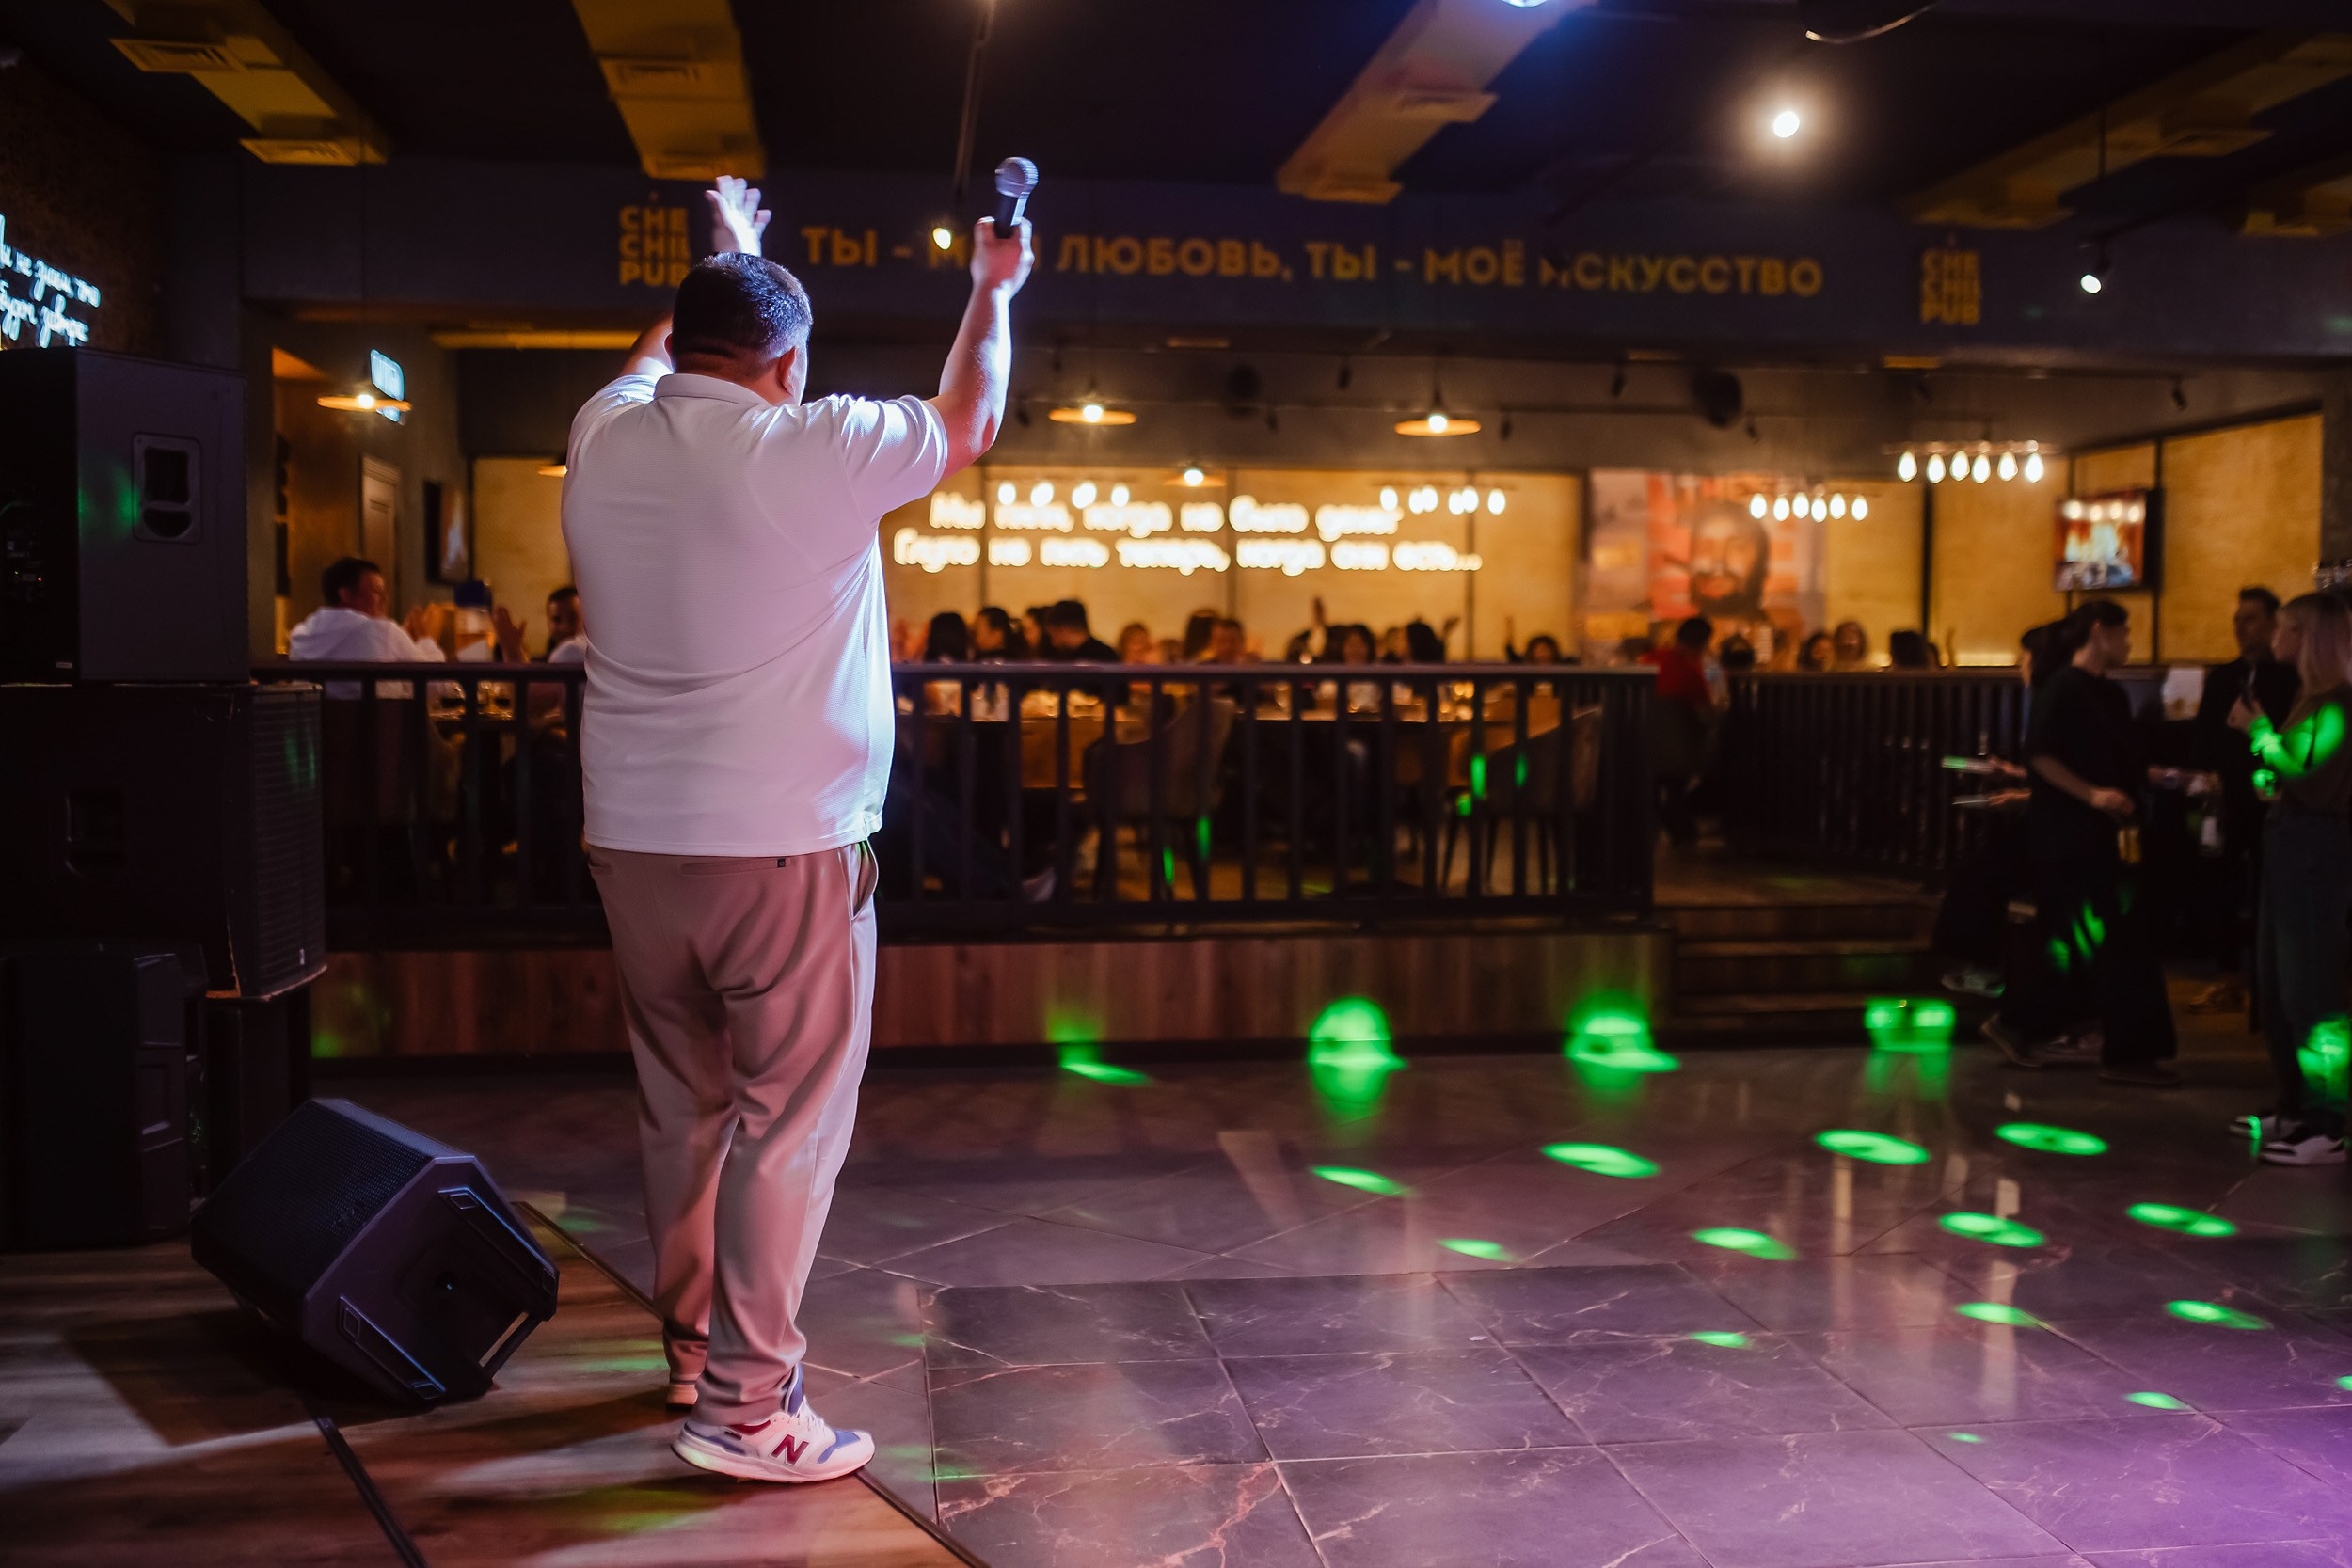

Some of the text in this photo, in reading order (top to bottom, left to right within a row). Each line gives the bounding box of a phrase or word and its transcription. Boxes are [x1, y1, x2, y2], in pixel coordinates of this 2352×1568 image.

[619, 205, 687, 232] CHE
[802, 226, 877, 267] ТЫ
[1057, 234, 1293, 283] ЛЮБОВЬ,
[1305, 241, 1376, 280] ТЫ
[1423, 239, 1525, 286] МОЁ
[1920, 302, 1980, 325] PUB
[771, 1434, 809, 1465] N
